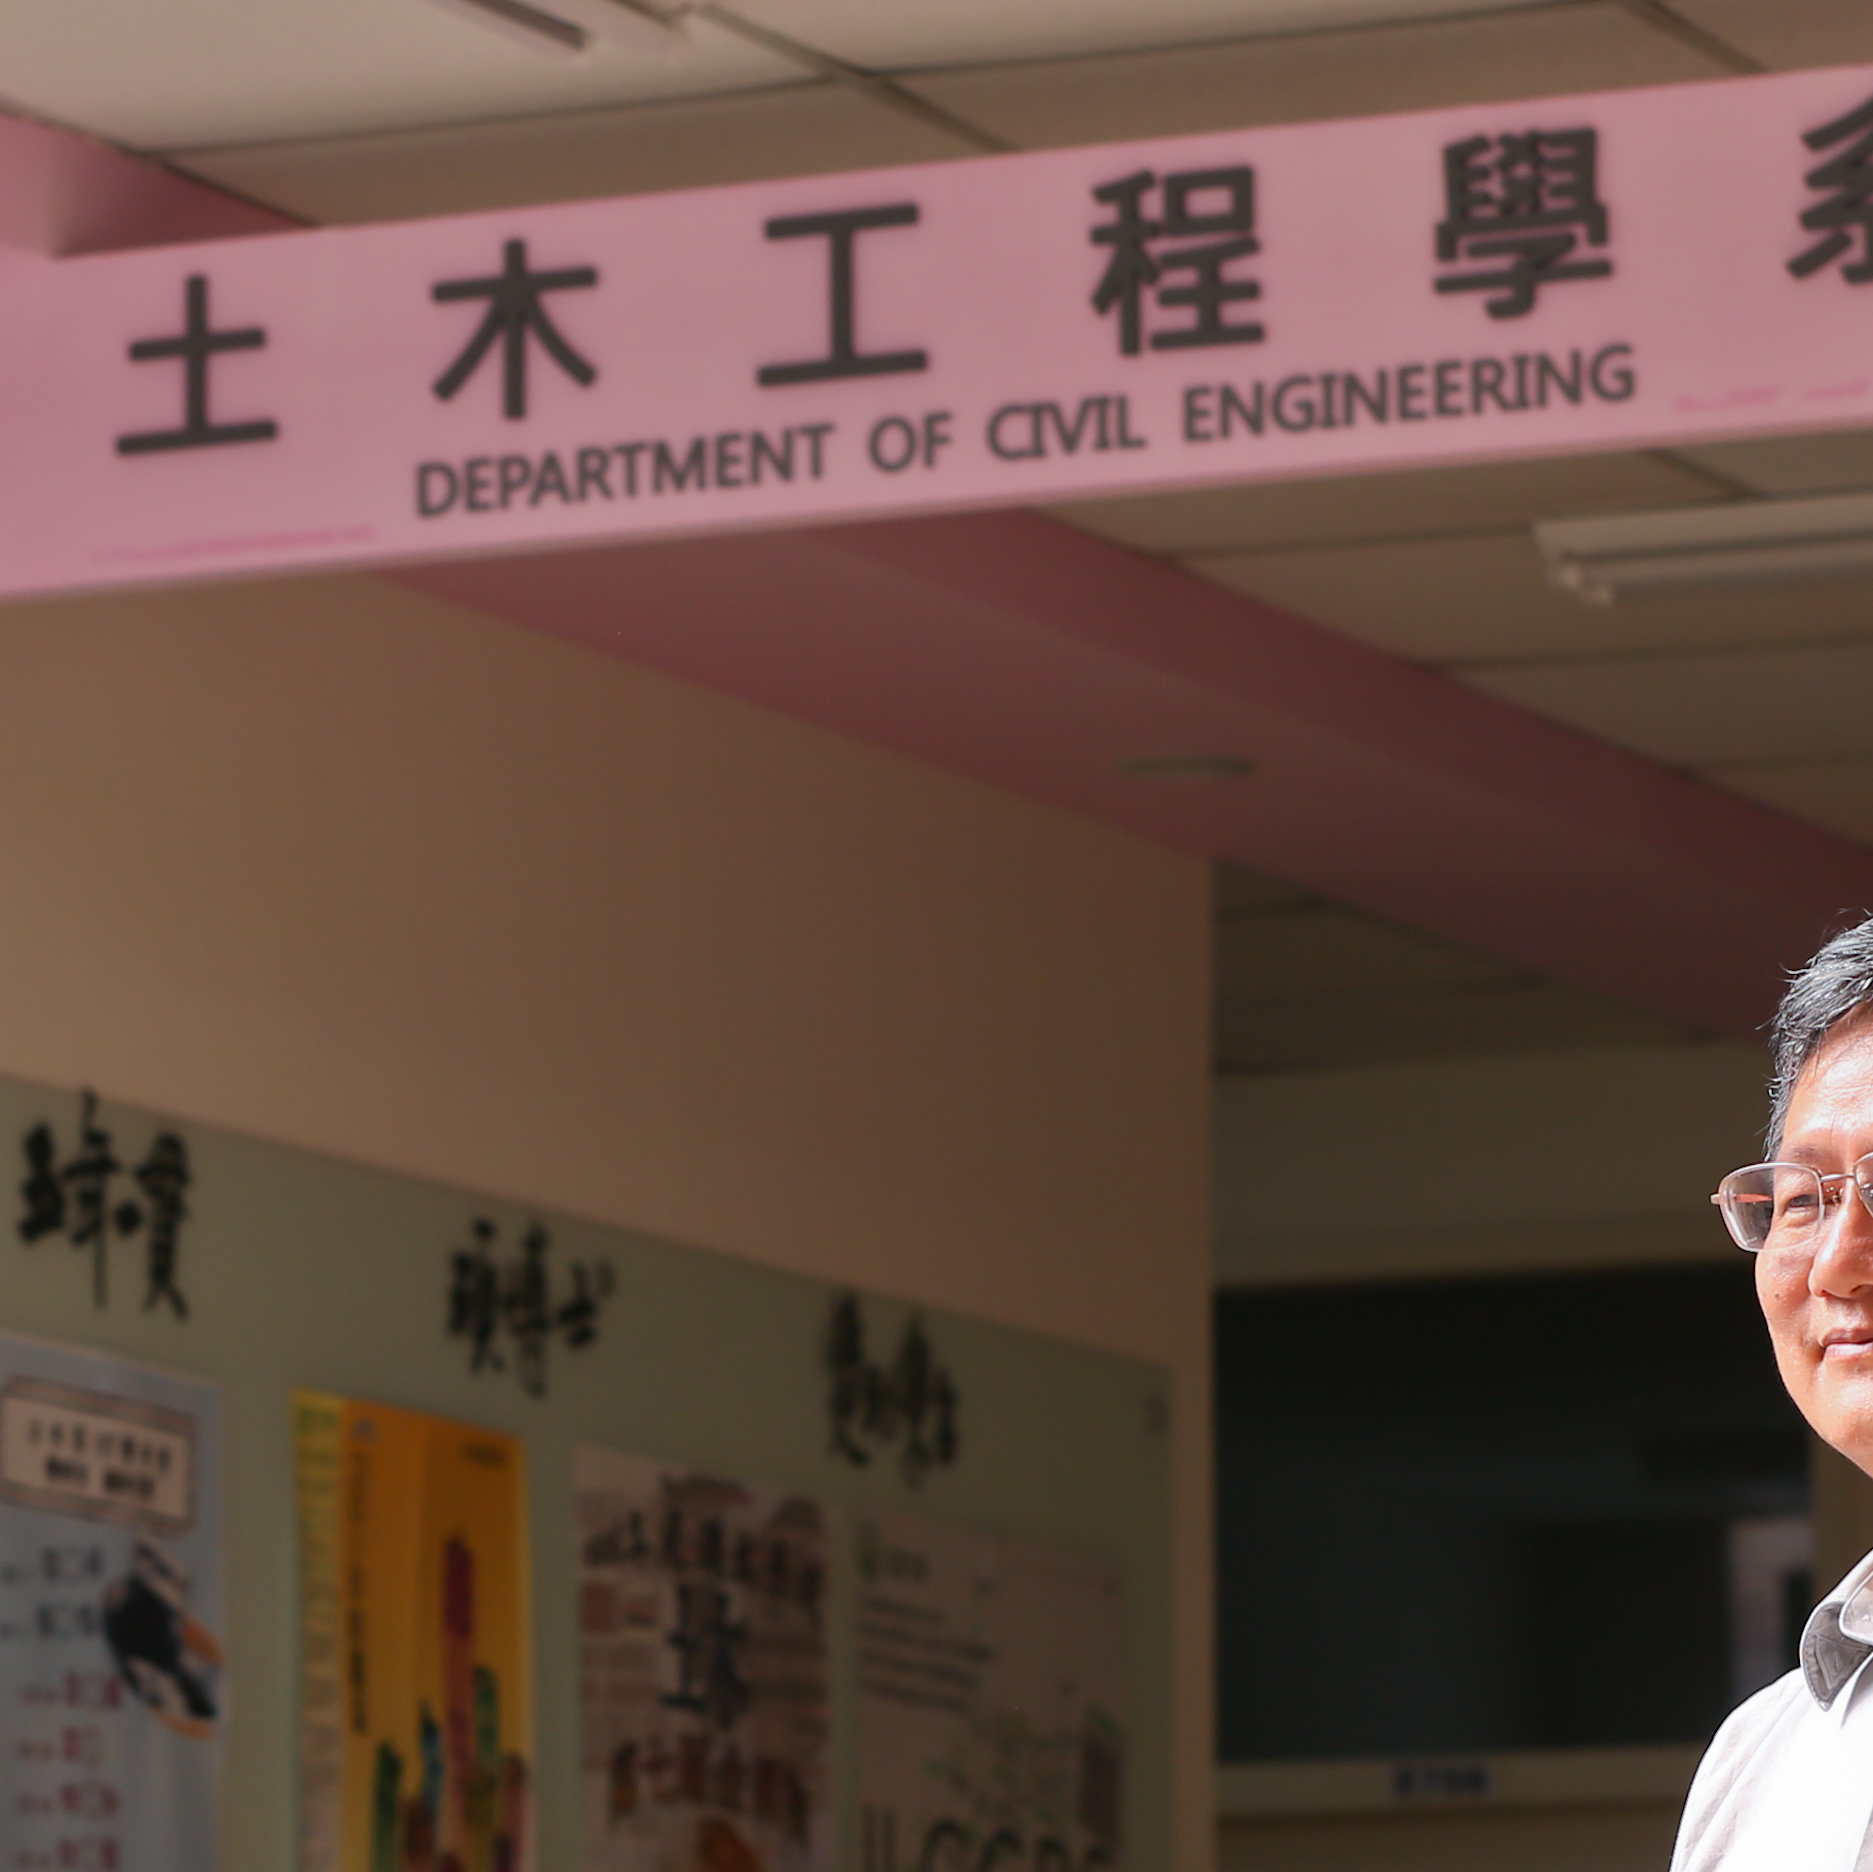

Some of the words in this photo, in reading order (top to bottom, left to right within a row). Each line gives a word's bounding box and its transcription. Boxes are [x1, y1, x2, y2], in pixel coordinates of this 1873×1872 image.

[415, 423, 832, 520] DEPARTMENT
[867, 411, 950, 473] OF
[986, 394, 1144, 461] CIVIL
[1182, 342, 1636, 443] ENGINEERING
